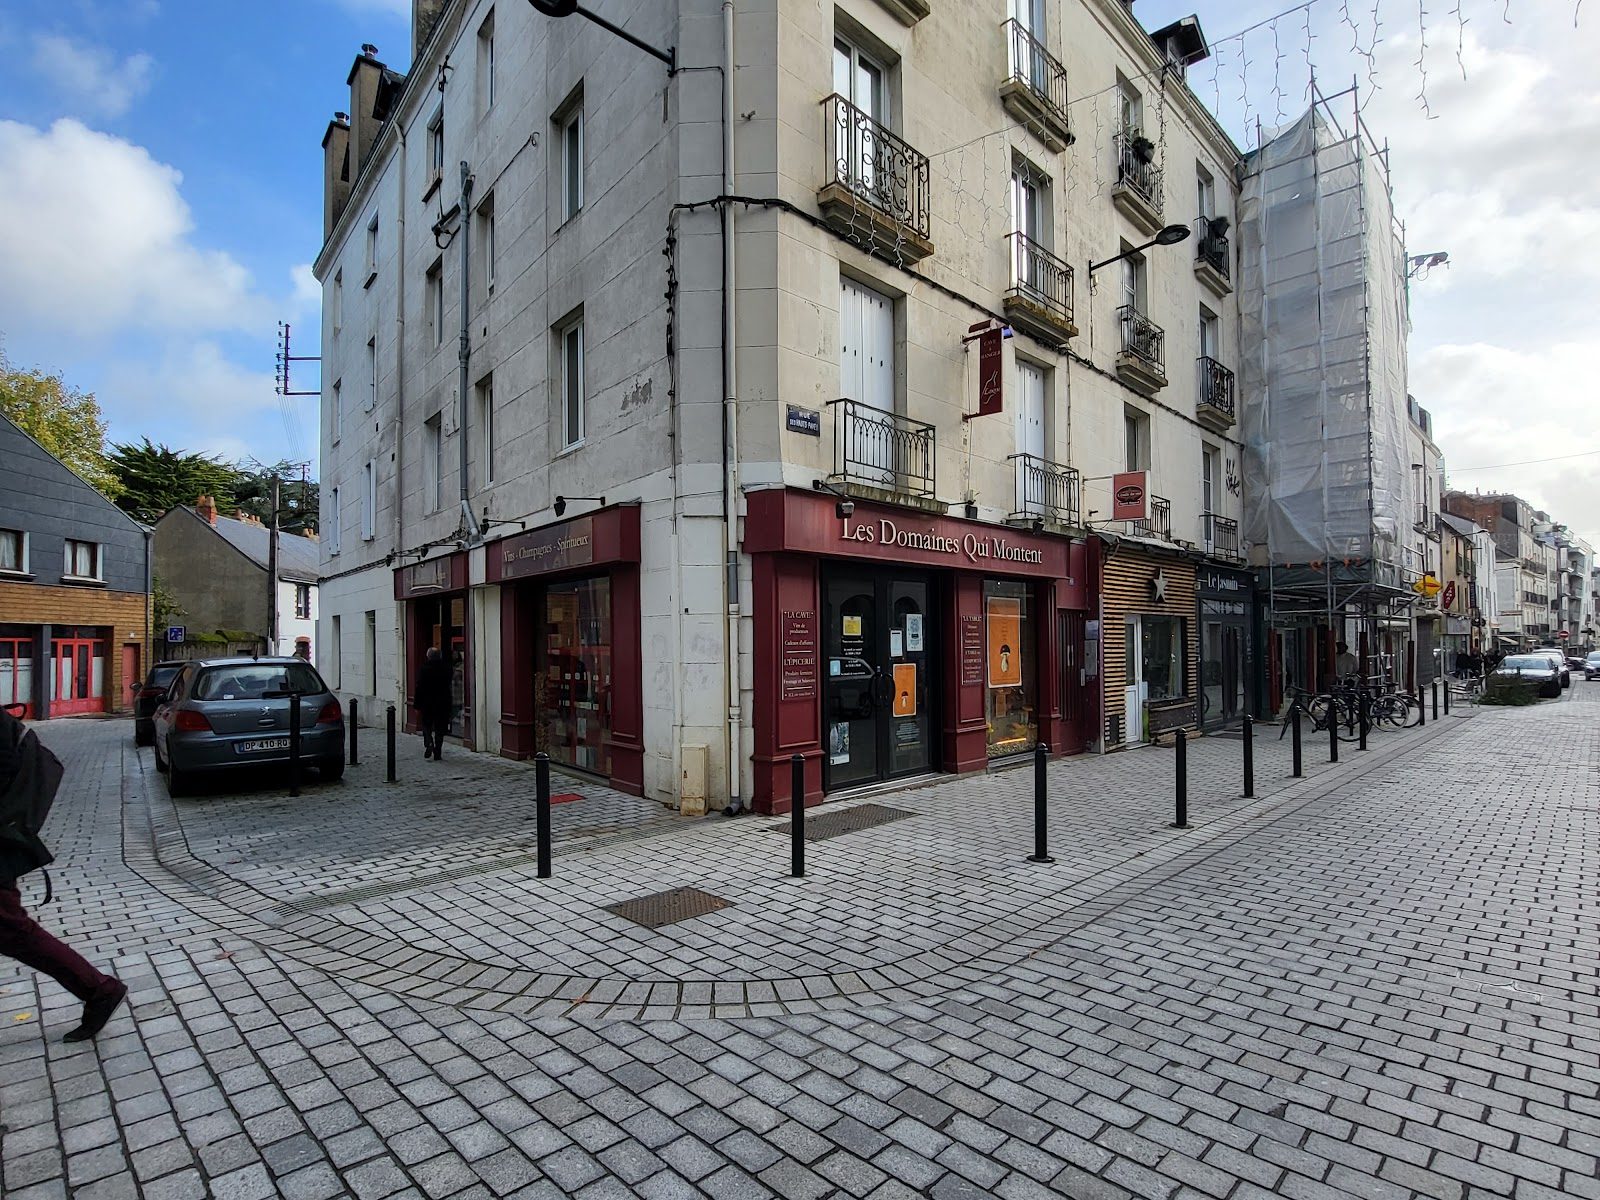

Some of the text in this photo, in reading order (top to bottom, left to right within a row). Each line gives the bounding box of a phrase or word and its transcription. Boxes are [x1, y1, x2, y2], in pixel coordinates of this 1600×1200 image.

[504, 535, 588, 562] Vins Champagnes Spiritueux
[841, 517, 1043, 564] Les Domaines Qui Montent
[1208, 572, 1238, 591] Le Jasmin
